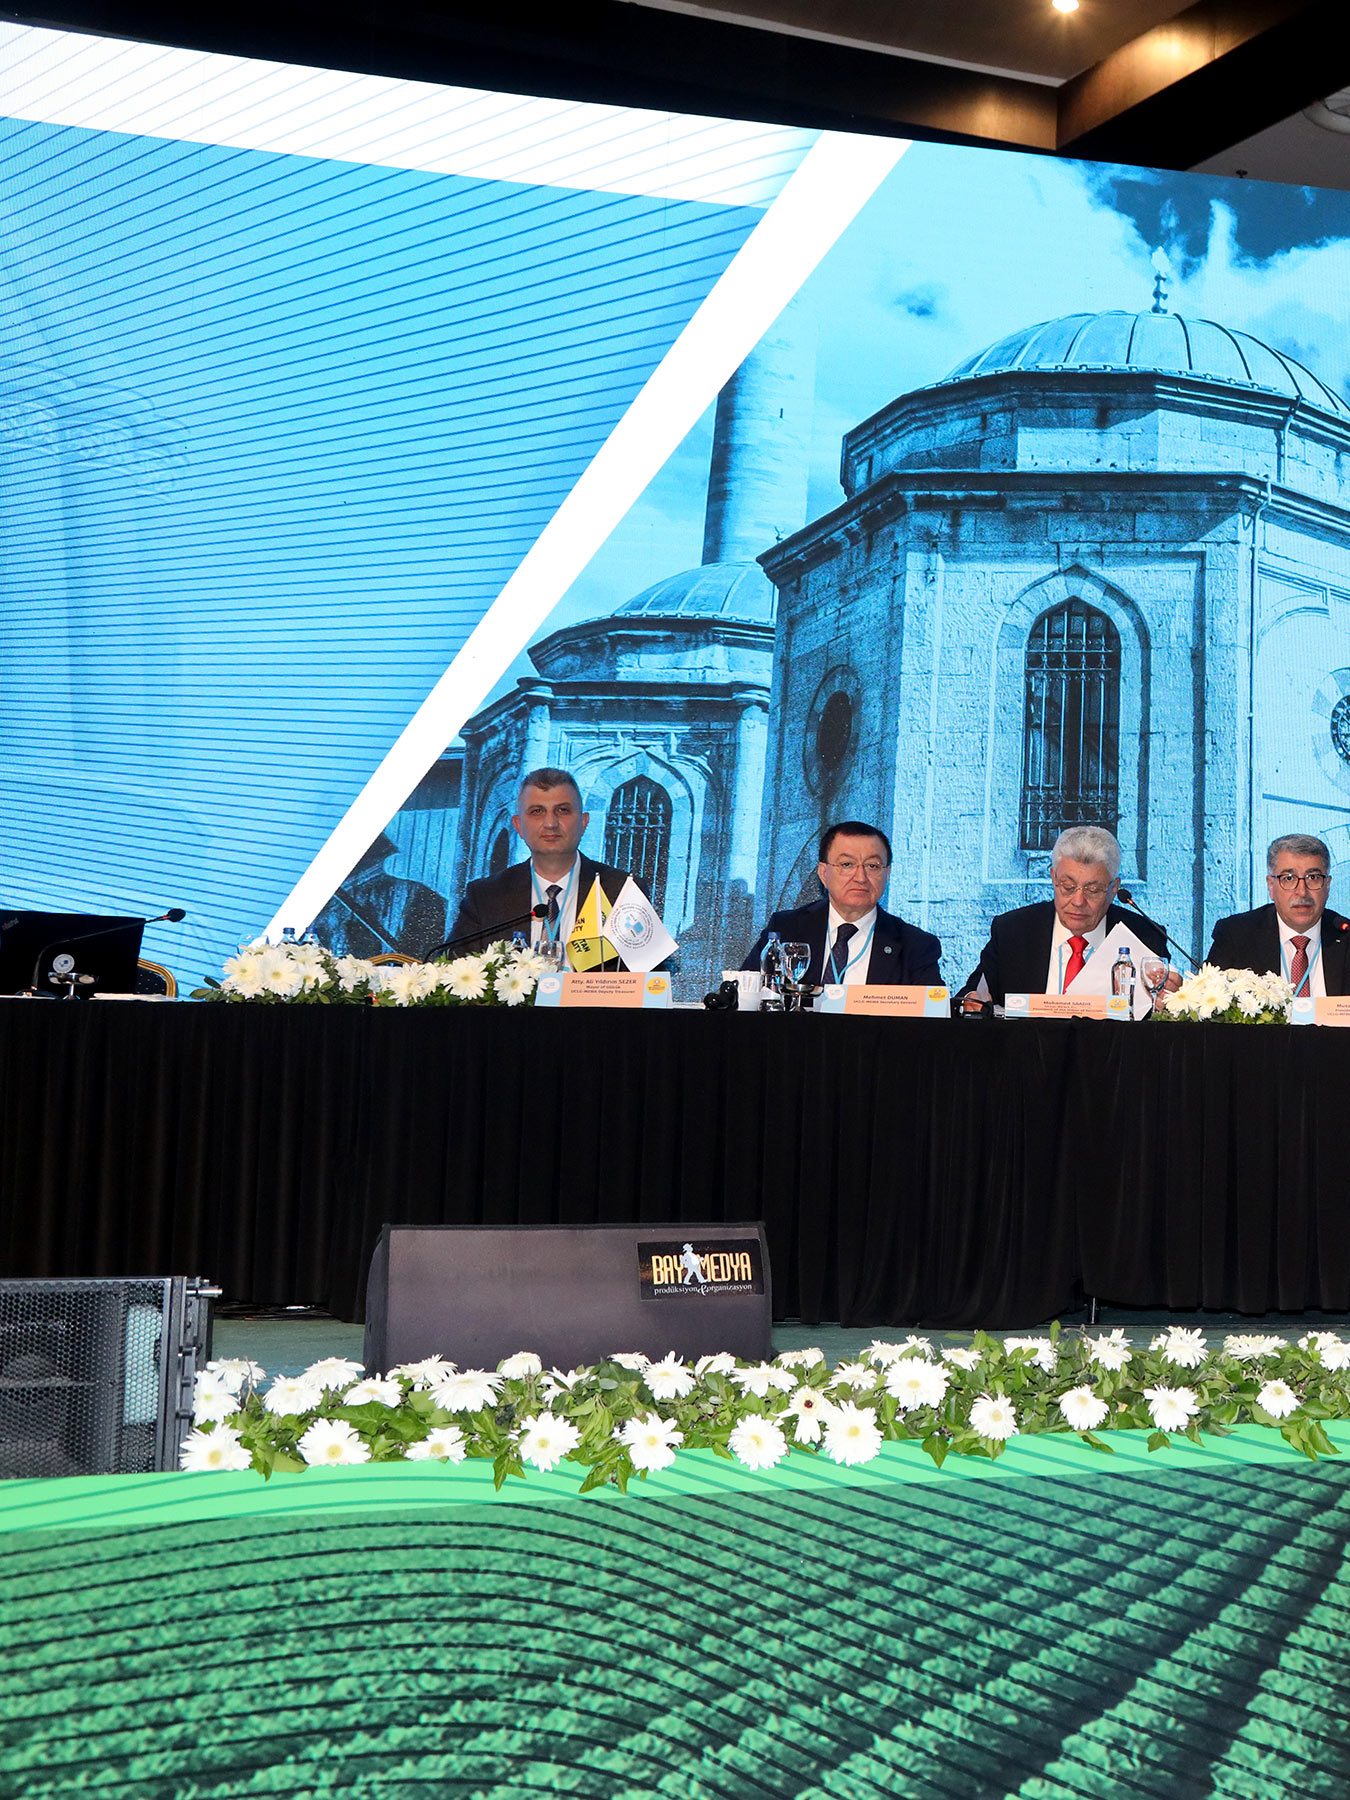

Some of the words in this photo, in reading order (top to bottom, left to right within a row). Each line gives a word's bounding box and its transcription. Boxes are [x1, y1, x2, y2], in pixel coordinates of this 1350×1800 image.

[651, 1255, 684, 1285] BAY
[696, 1252, 752, 1283] MEDYA
[654, 1285, 698, 1296] prodüksiyon
[707, 1283, 752, 1293] organizasyon
